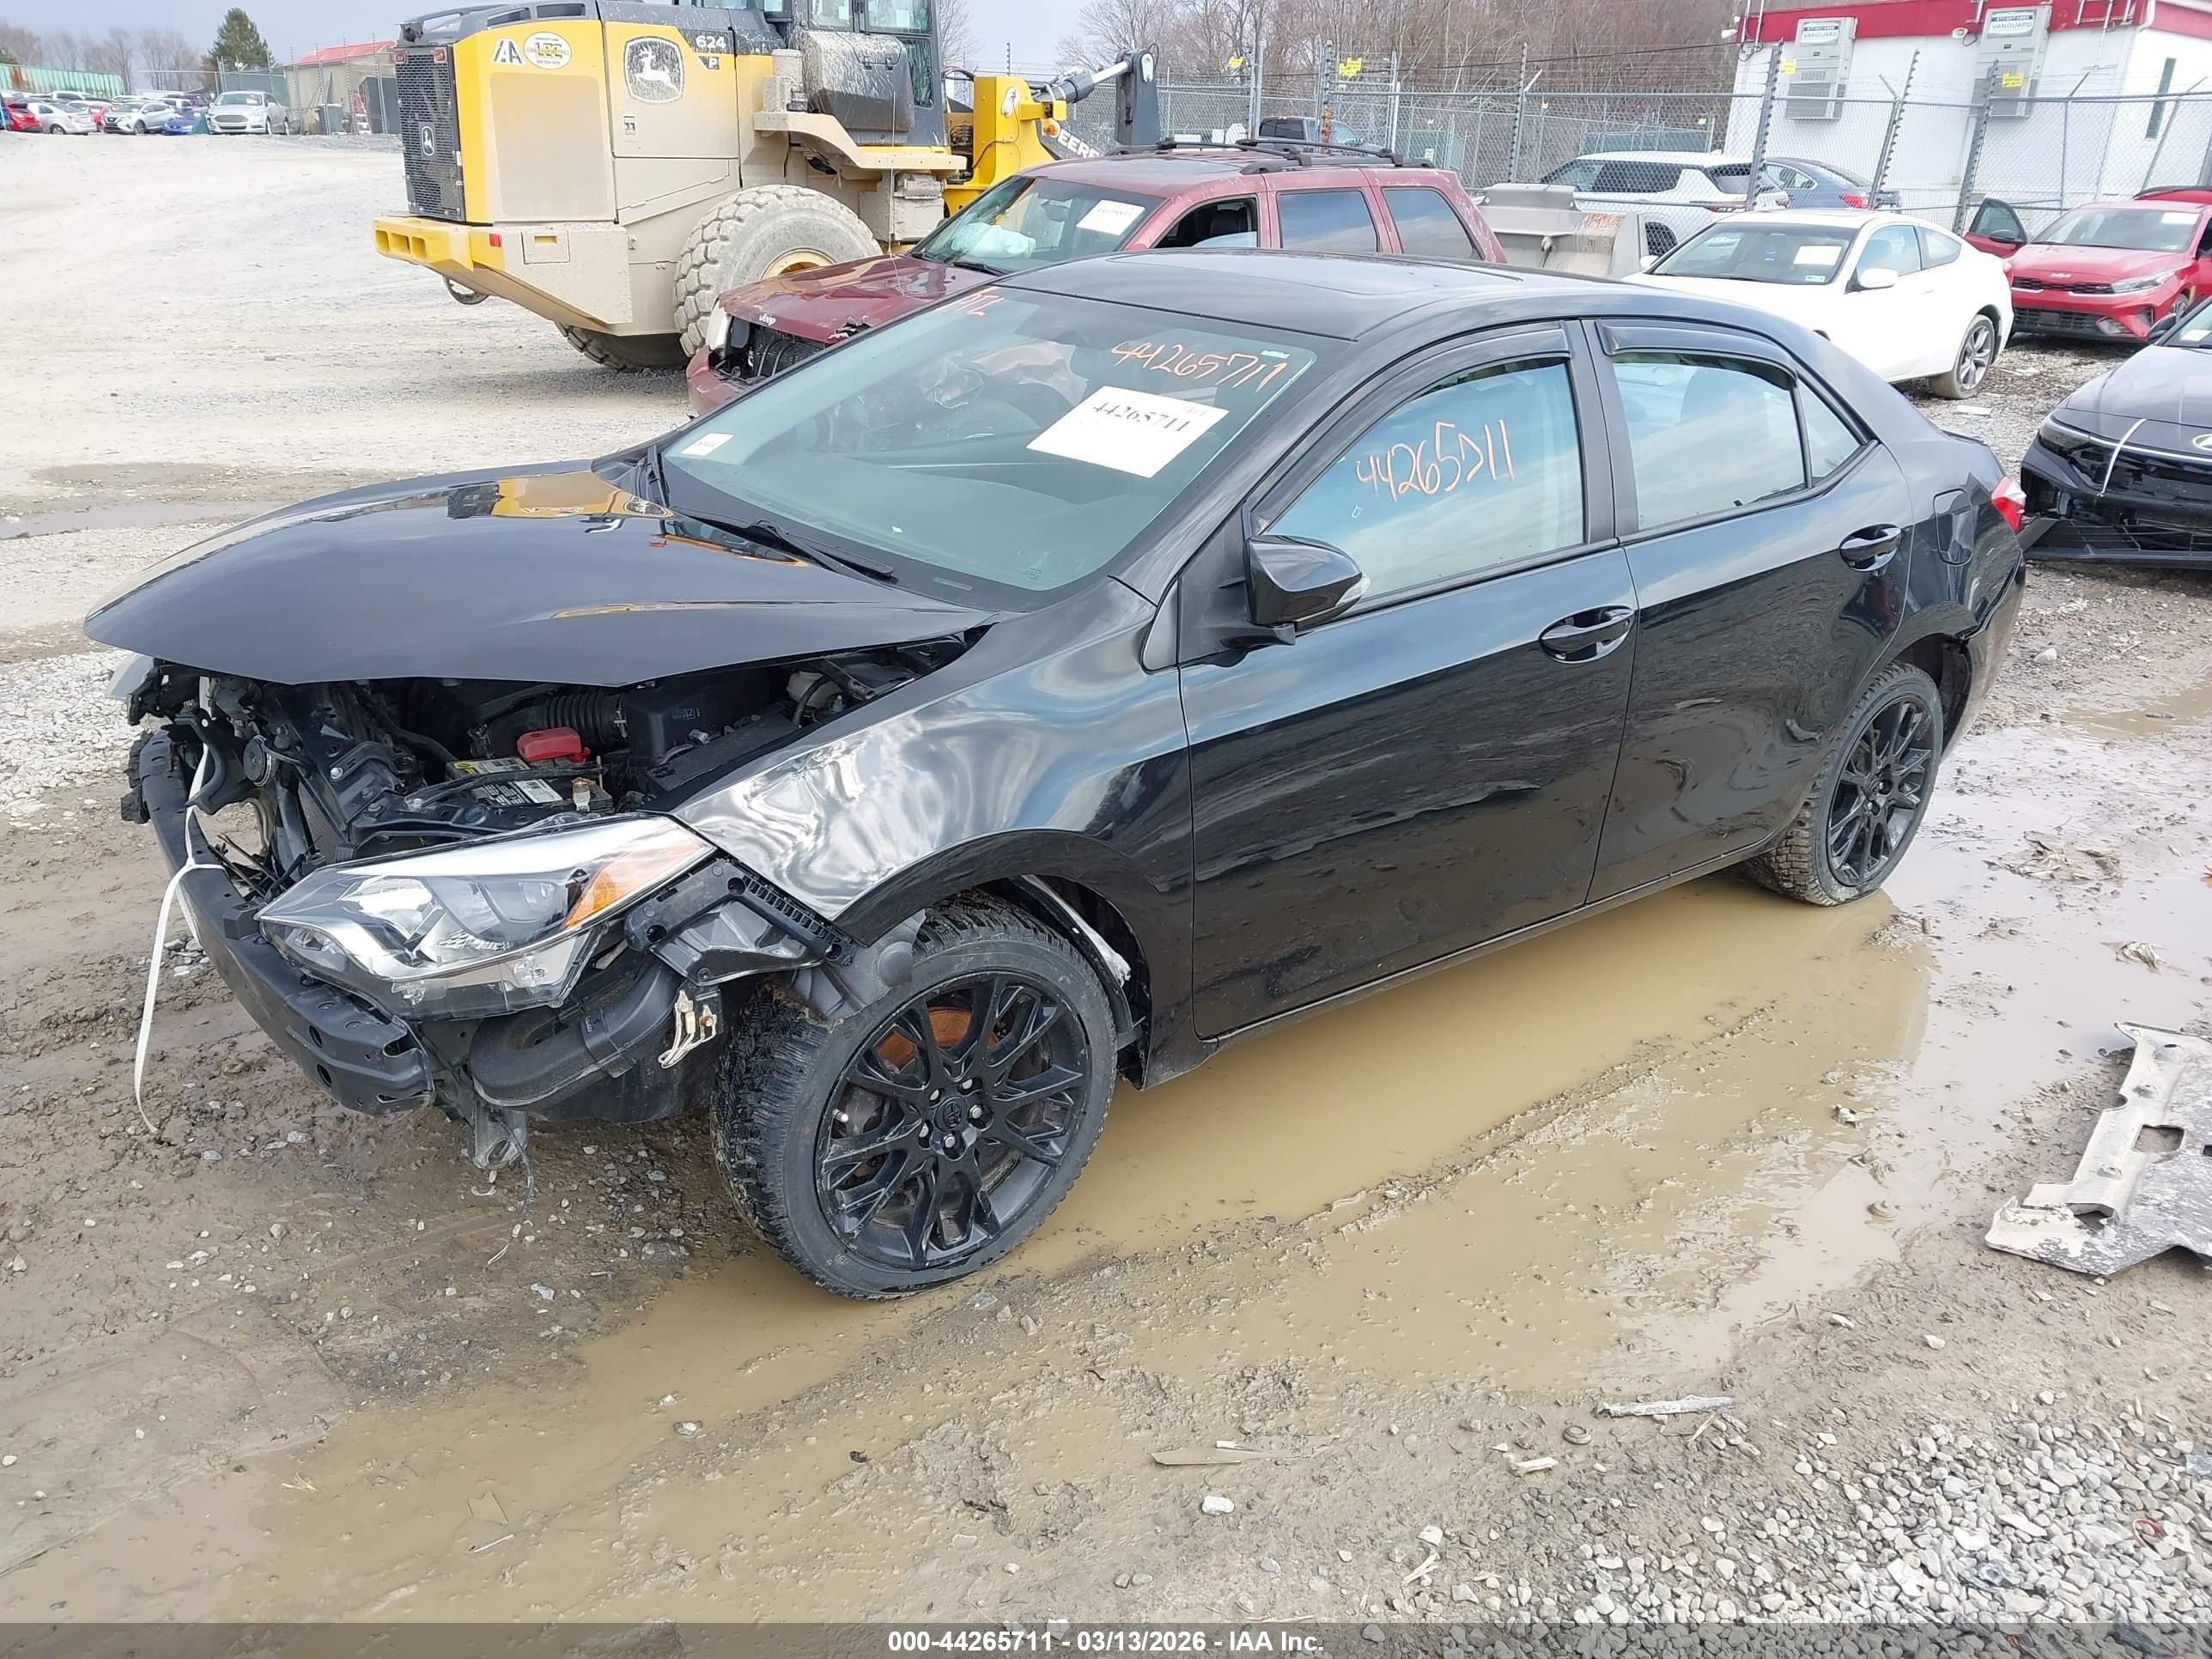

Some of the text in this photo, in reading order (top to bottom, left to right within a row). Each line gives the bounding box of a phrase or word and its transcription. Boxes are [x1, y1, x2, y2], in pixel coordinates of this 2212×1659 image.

[696, 35, 726, 49] 624
[708, 57, 718, 69] P
[1111, 341, 1288, 392] 44265711
[1092, 401, 1192, 433] 44265711
